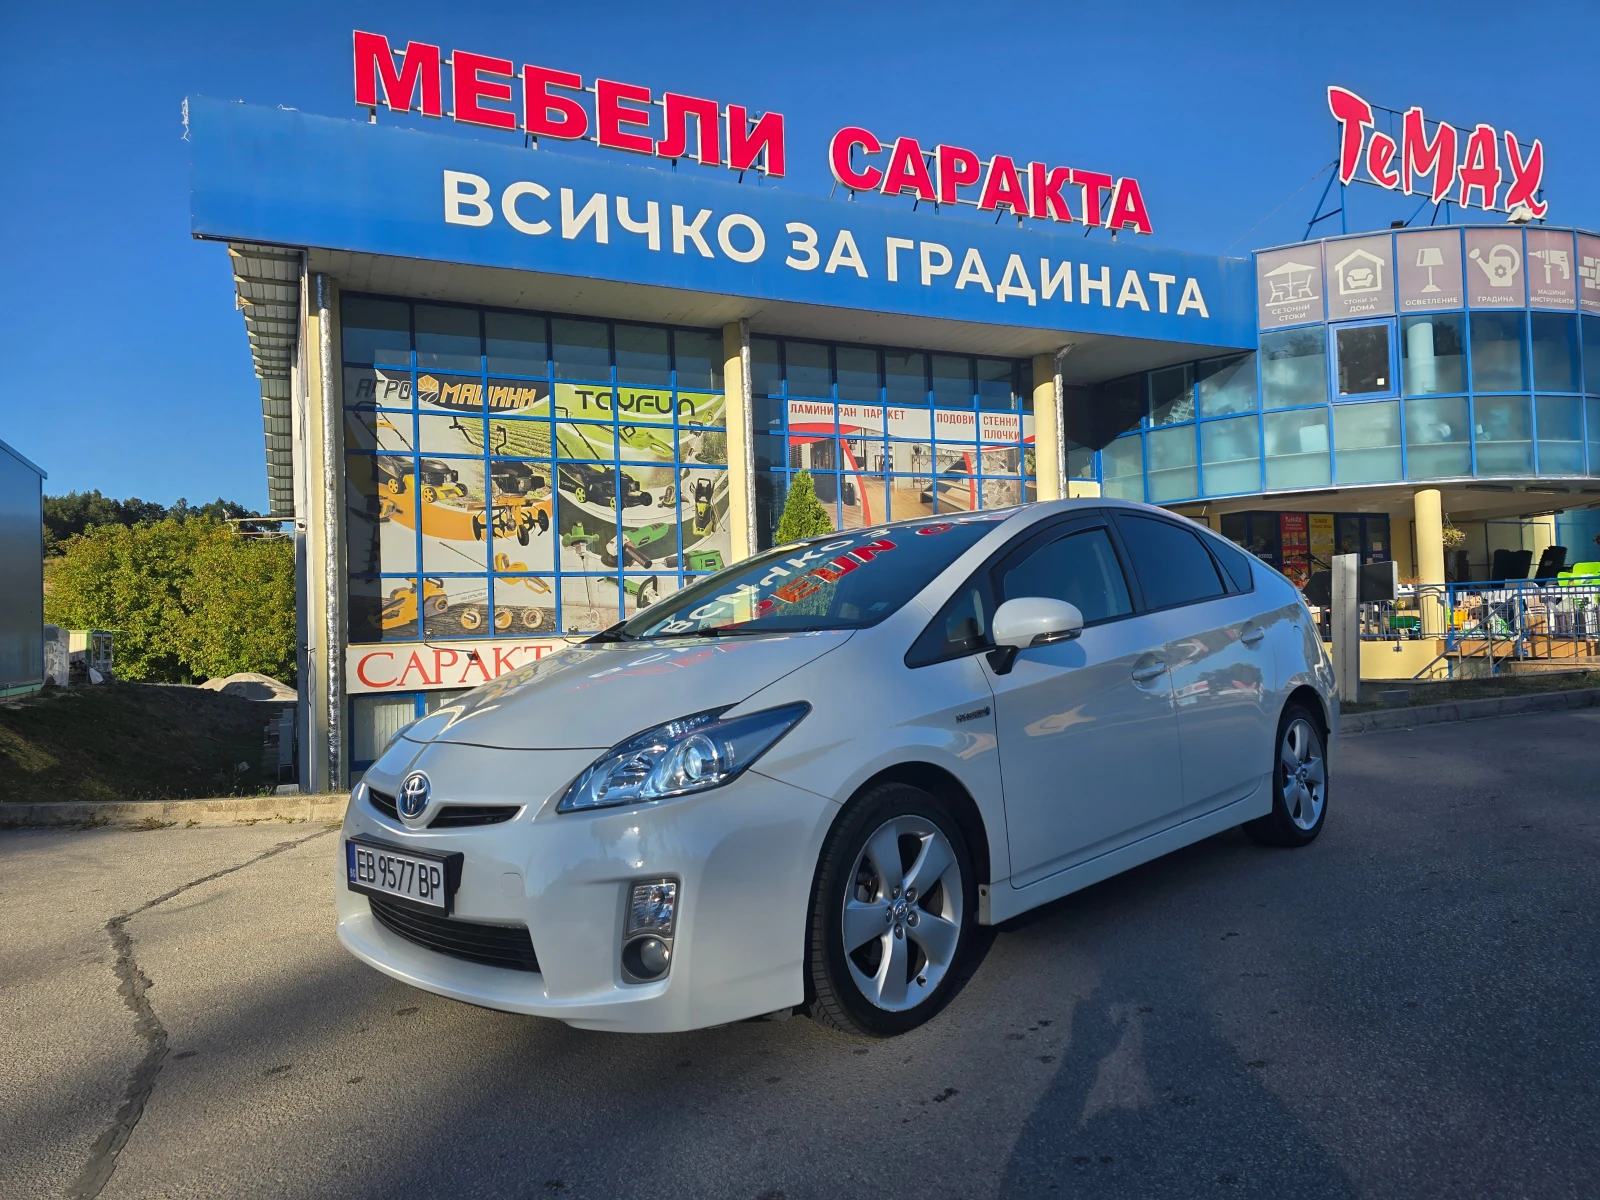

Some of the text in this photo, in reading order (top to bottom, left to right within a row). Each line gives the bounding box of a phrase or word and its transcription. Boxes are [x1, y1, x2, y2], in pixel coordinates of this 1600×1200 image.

[353, 29, 1154, 235] МЕБЕЛИ САРАКТА
[443, 169, 1210, 319] ВСИЧКО ЗА ГРАДИНАТА
[1343, 297, 1368, 305] СТОКИ
[1405, 296, 1459, 306] ОСВЕТЛЕНИЕ
[1530, 296, 1575, 305] ИНСТРУМЕНТИ
[1271, 304, 1311, 315] СЕЗОННИ
[1349, 304, 1376, 313] ДОМА
[1278, 313, 1306, 322] СТОКИ
[356, 378, 537, 408] АГРО МАШИНИ
[790, 403, 906, 420] ЛАМИНИРАН ПАРКЕТ
[936, 413, 1018, 427] ПОДОВИ СТЕННИ
[984, 429, 1020, 440] ПЛОЧКИ
[378, 854, 415, 894] 9577
